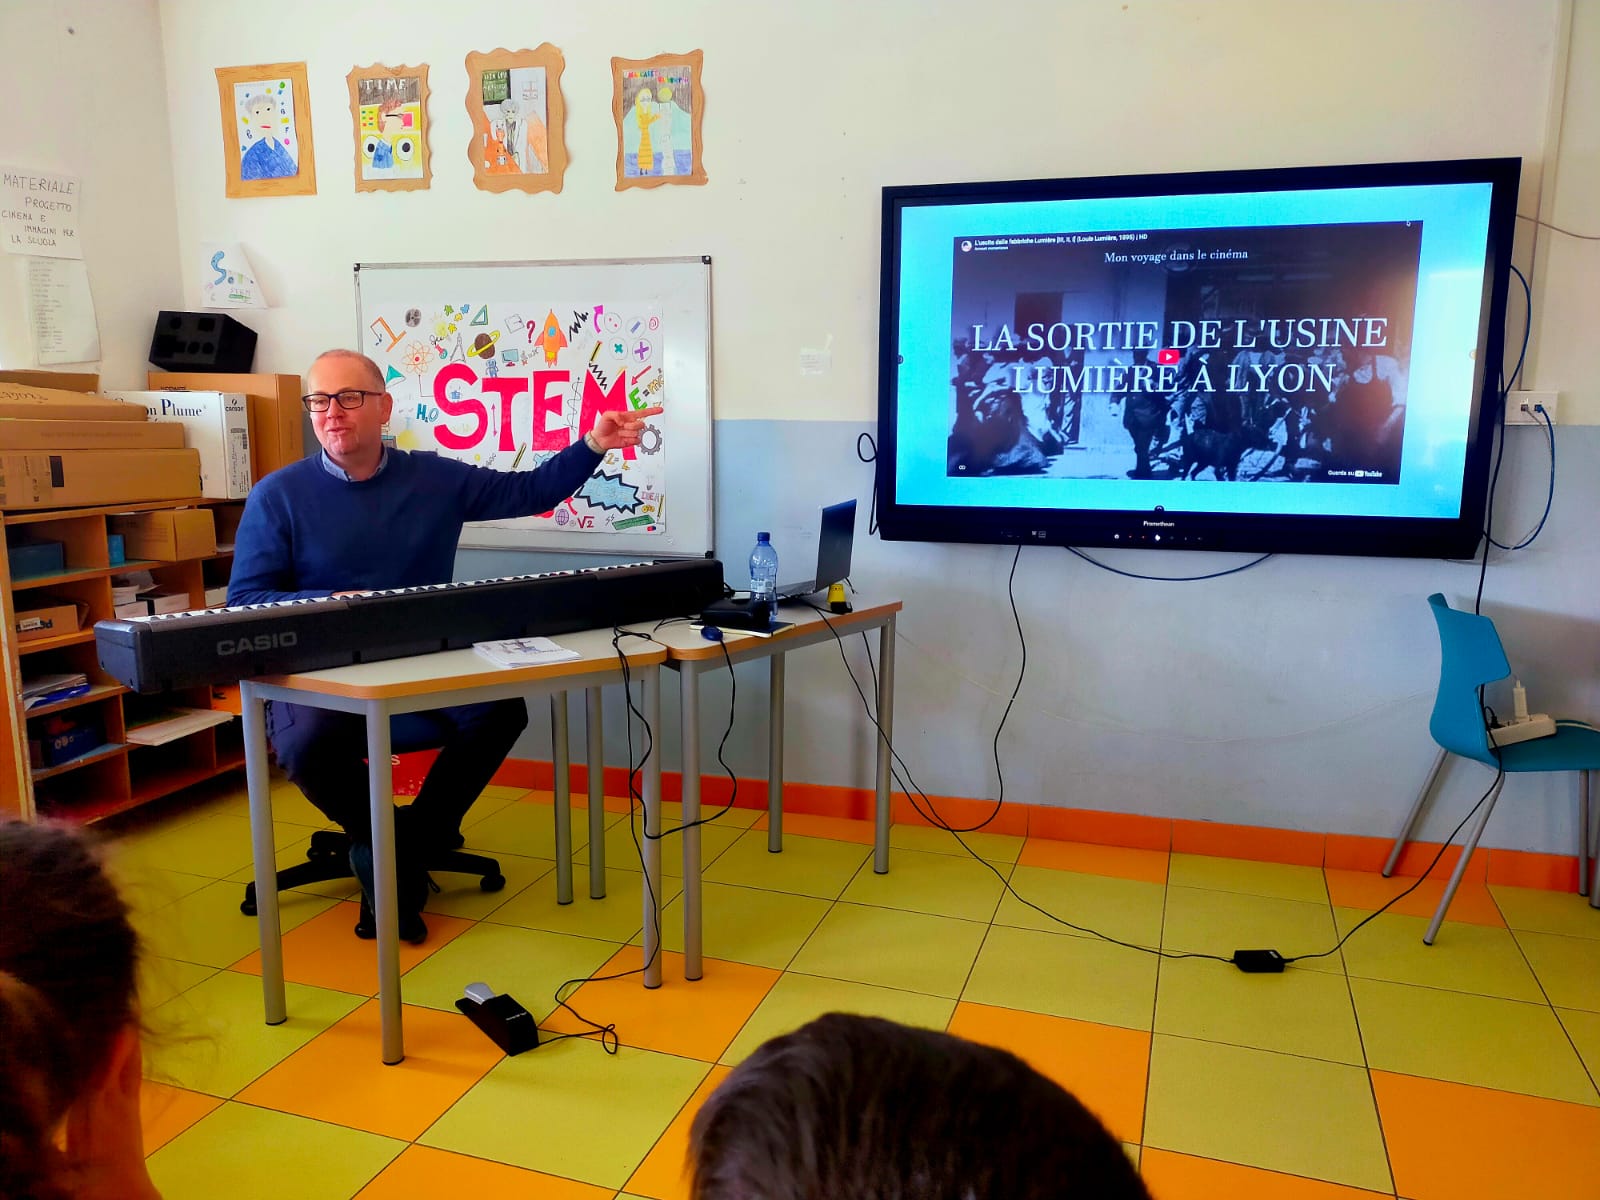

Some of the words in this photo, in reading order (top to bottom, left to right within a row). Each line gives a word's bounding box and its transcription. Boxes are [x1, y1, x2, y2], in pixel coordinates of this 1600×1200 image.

[365, 79, 406, 90] TIME
[3, 173, 74, 194] MATERIALE
[25, 196, 72, 212] PROGETTO
[1, 209, 33, 221] CINEMA
[40, 214, 46, 222] E
[24, 225, 57, 236] IMMAGINI
[63, 228, 74, 237] PER
[11, 234, 21, 244] LA
[27, 236, 57, 247] SCUOLA
[1104, 252, 1128, 263] Mon
[1130, 253, 1167, 265] voyage
[1169, 250, 1194, 261] dans
[1197, 250, 1207, 260] le
[1209, 249, 1249, 260] cinéma
[972, 324, 1017, 352] LA
[1026, 321, 1159, 350] SORTIE
[1169, 319, 1222, 349] DE
[1232, 317, 1388, 349] L'USINE
[1012, 357, 1179, 393] LUMIÈRE
[1193, 357, 1214, 392] À
[1225, 363, 1337, 392] LYON
[160, 398, 202, 417] Plume
[433, 362, 637, 460] STEM
[216, 631, 298, 656] CASIO
